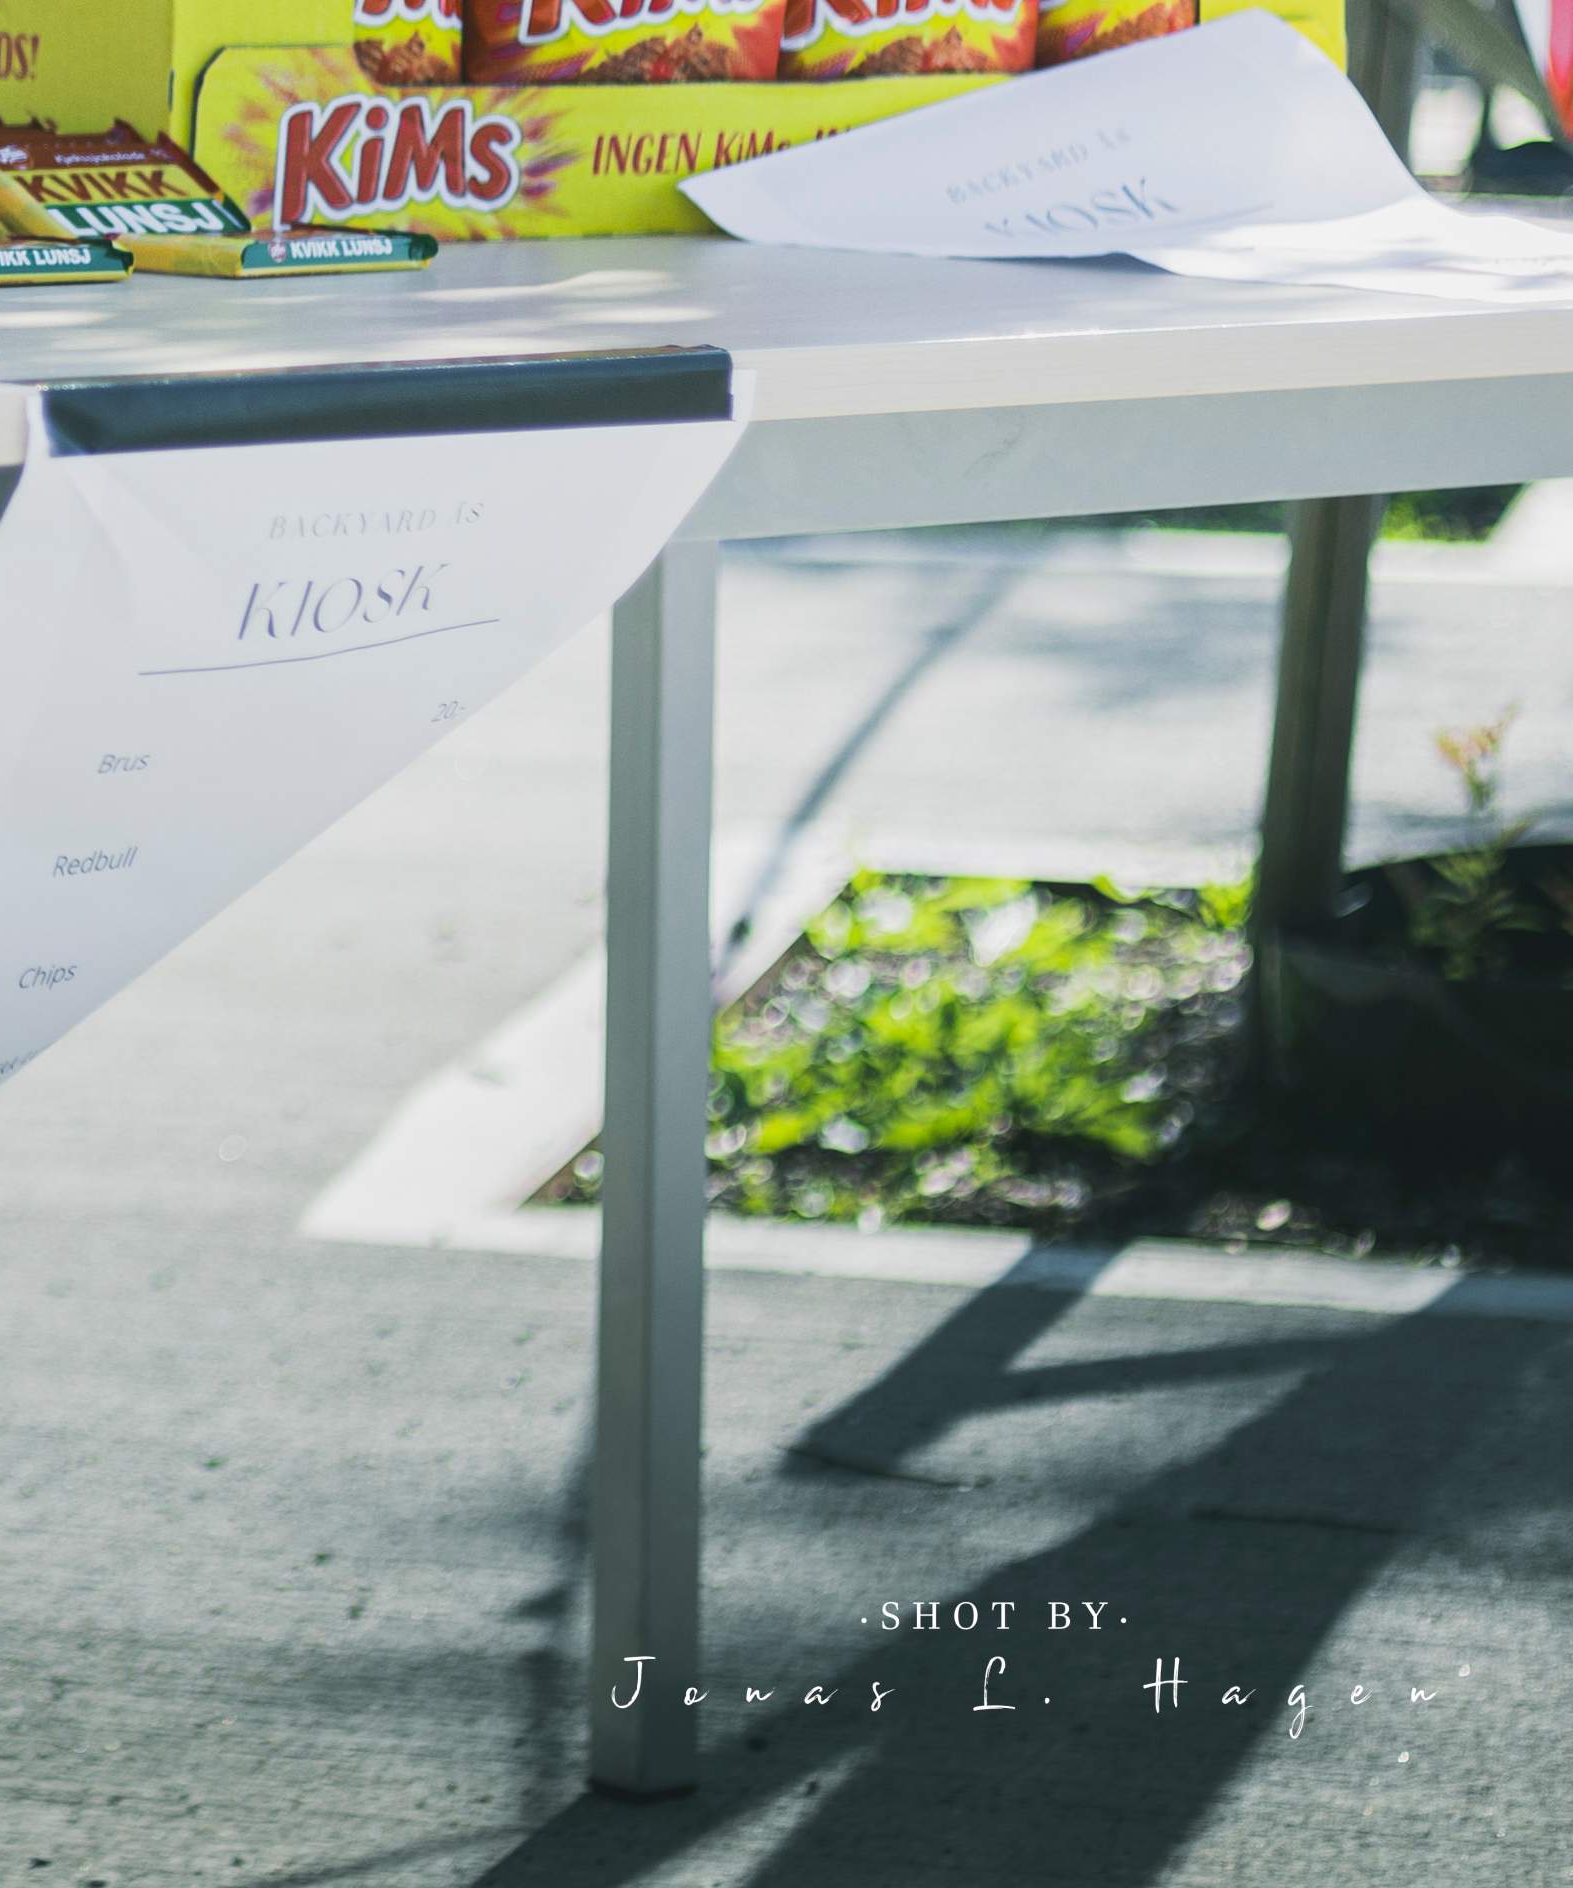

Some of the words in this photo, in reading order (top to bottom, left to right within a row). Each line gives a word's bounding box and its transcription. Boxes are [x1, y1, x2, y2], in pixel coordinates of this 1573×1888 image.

[273, 92, 525, 231] KiMs
[592, 131, 702, 176] INGEN
[13, 170, 187, 203] KVIKK
[46, 202, 224, 238] LUNSJ
[32, 247, 92, 266] LUNSJ
[289, 240, 340, 259] KVIKK
[269, 505, 439, 541] BACKYARD
[237, 561, 451, 641] KIOSK
[97, 752, 149, 775] Brus
[53, 845, 139, 877] Redbull
[18, 963, 78, 991] Chips
